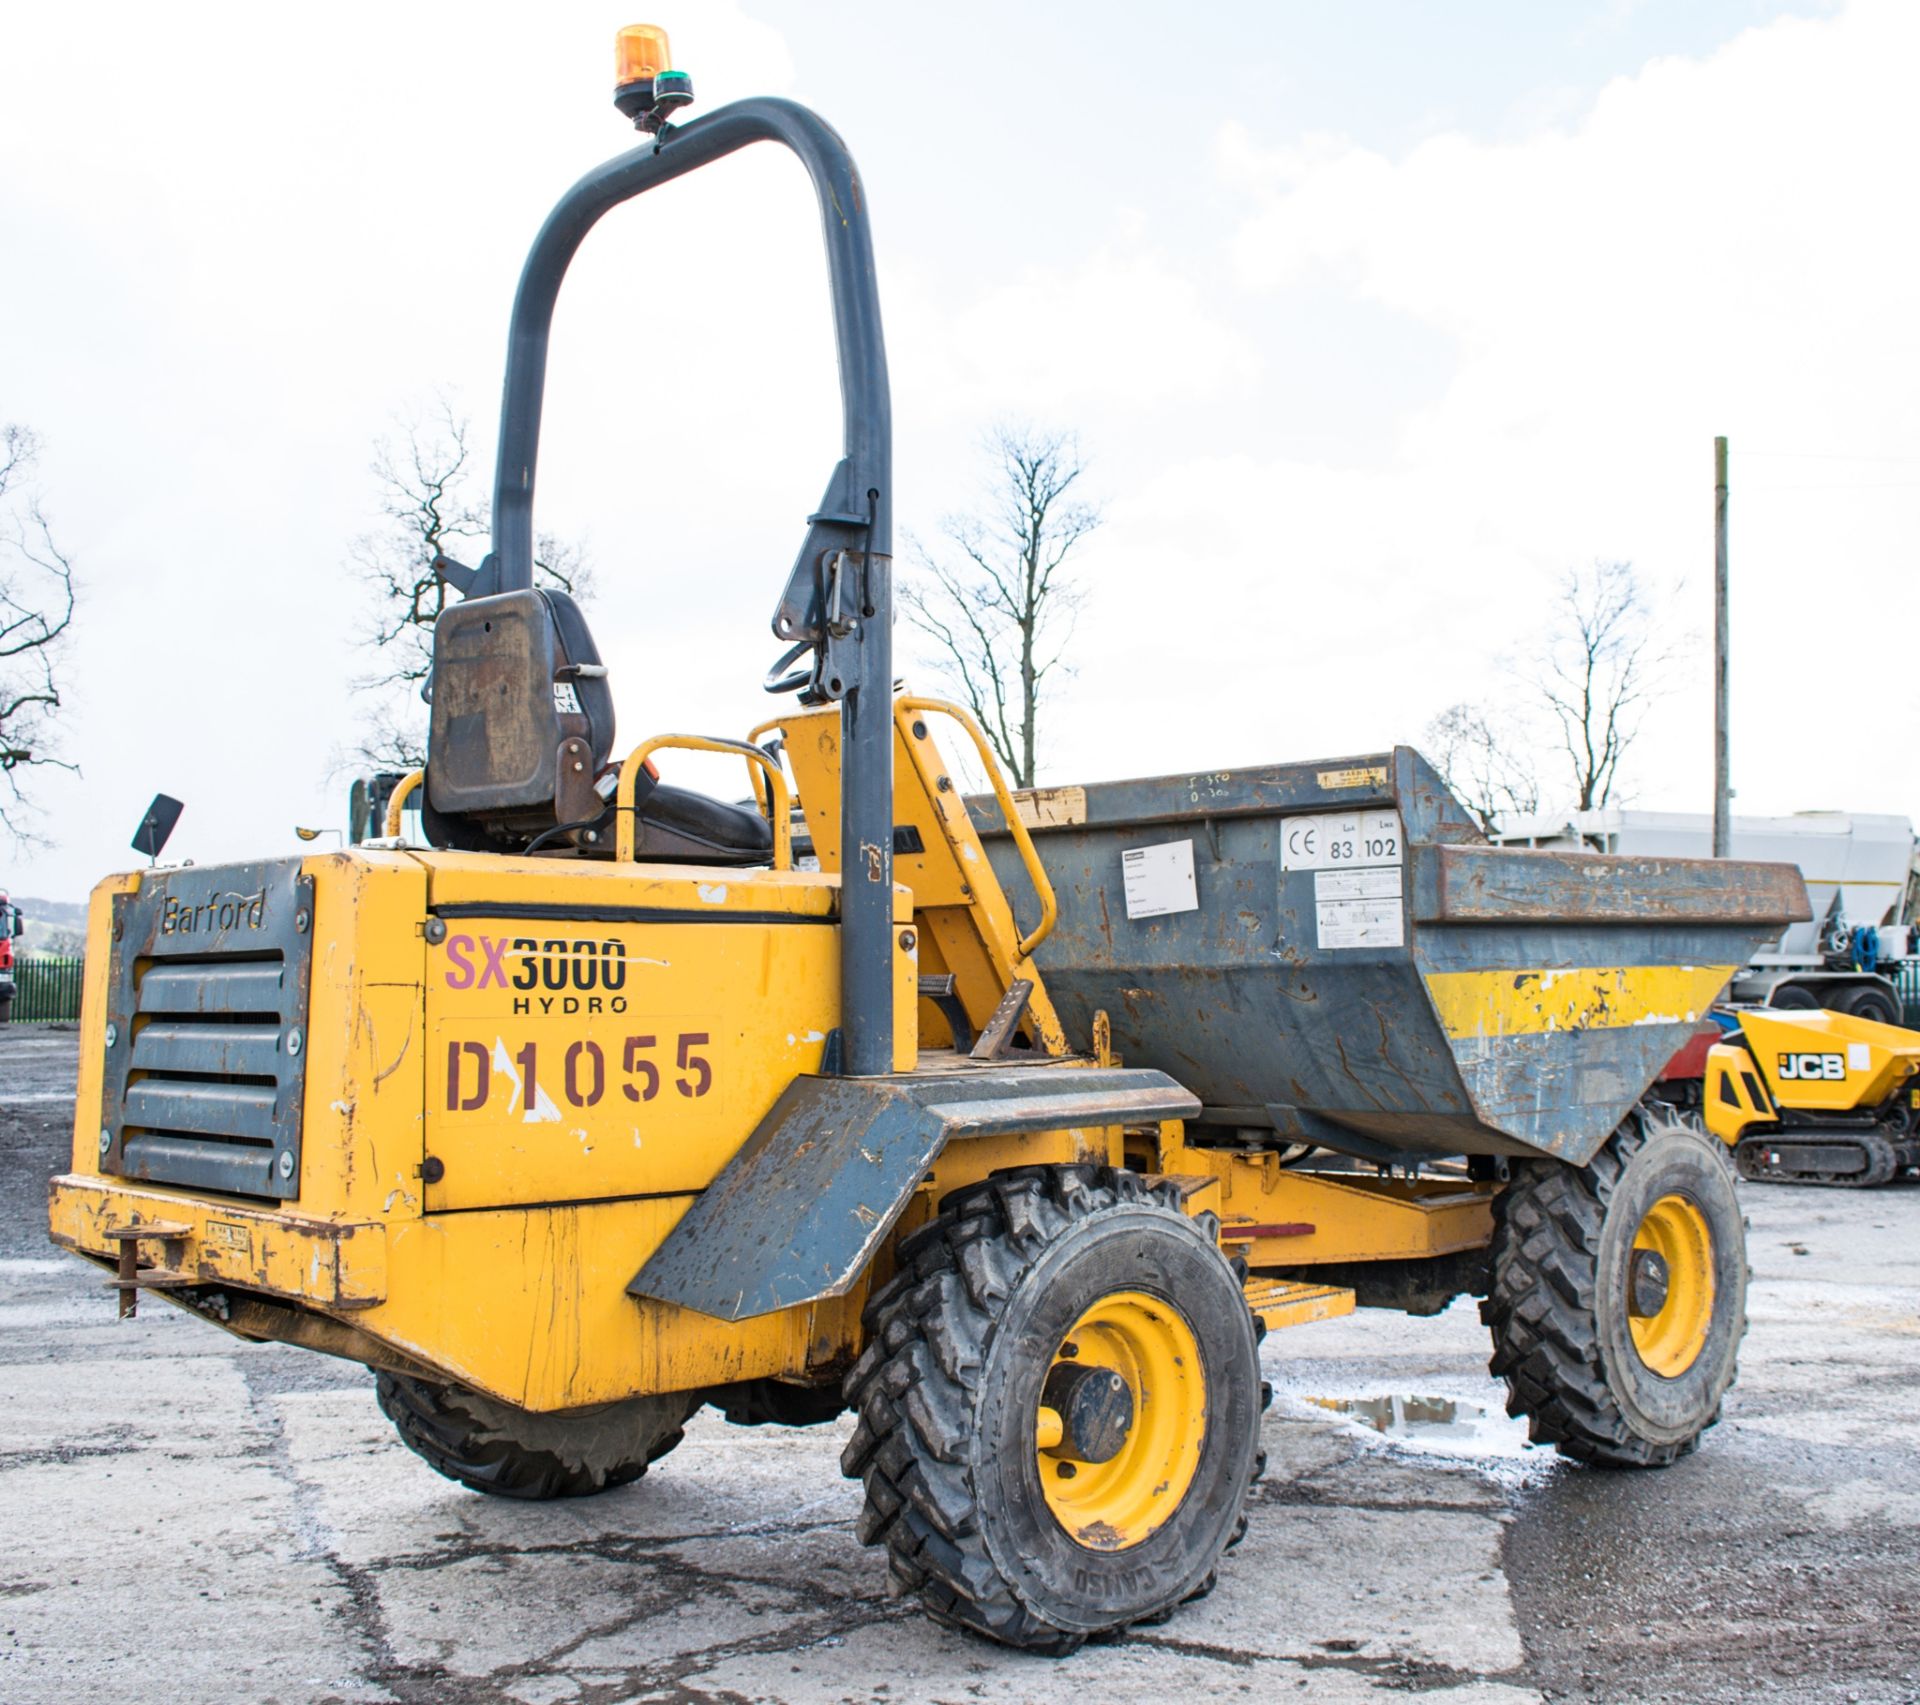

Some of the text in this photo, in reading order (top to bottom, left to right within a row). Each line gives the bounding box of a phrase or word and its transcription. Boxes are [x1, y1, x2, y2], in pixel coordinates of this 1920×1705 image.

[1330, 838, 1396, 860] 83 102
[162, 888, 266, 935] Barford
[445, 934, 626, 991] SX3000
[513, 996, 628, 1015] HYDRO
[446, 1032, 712, 1112] D1055
[1779, 1054, 1845, 1079] JCB
